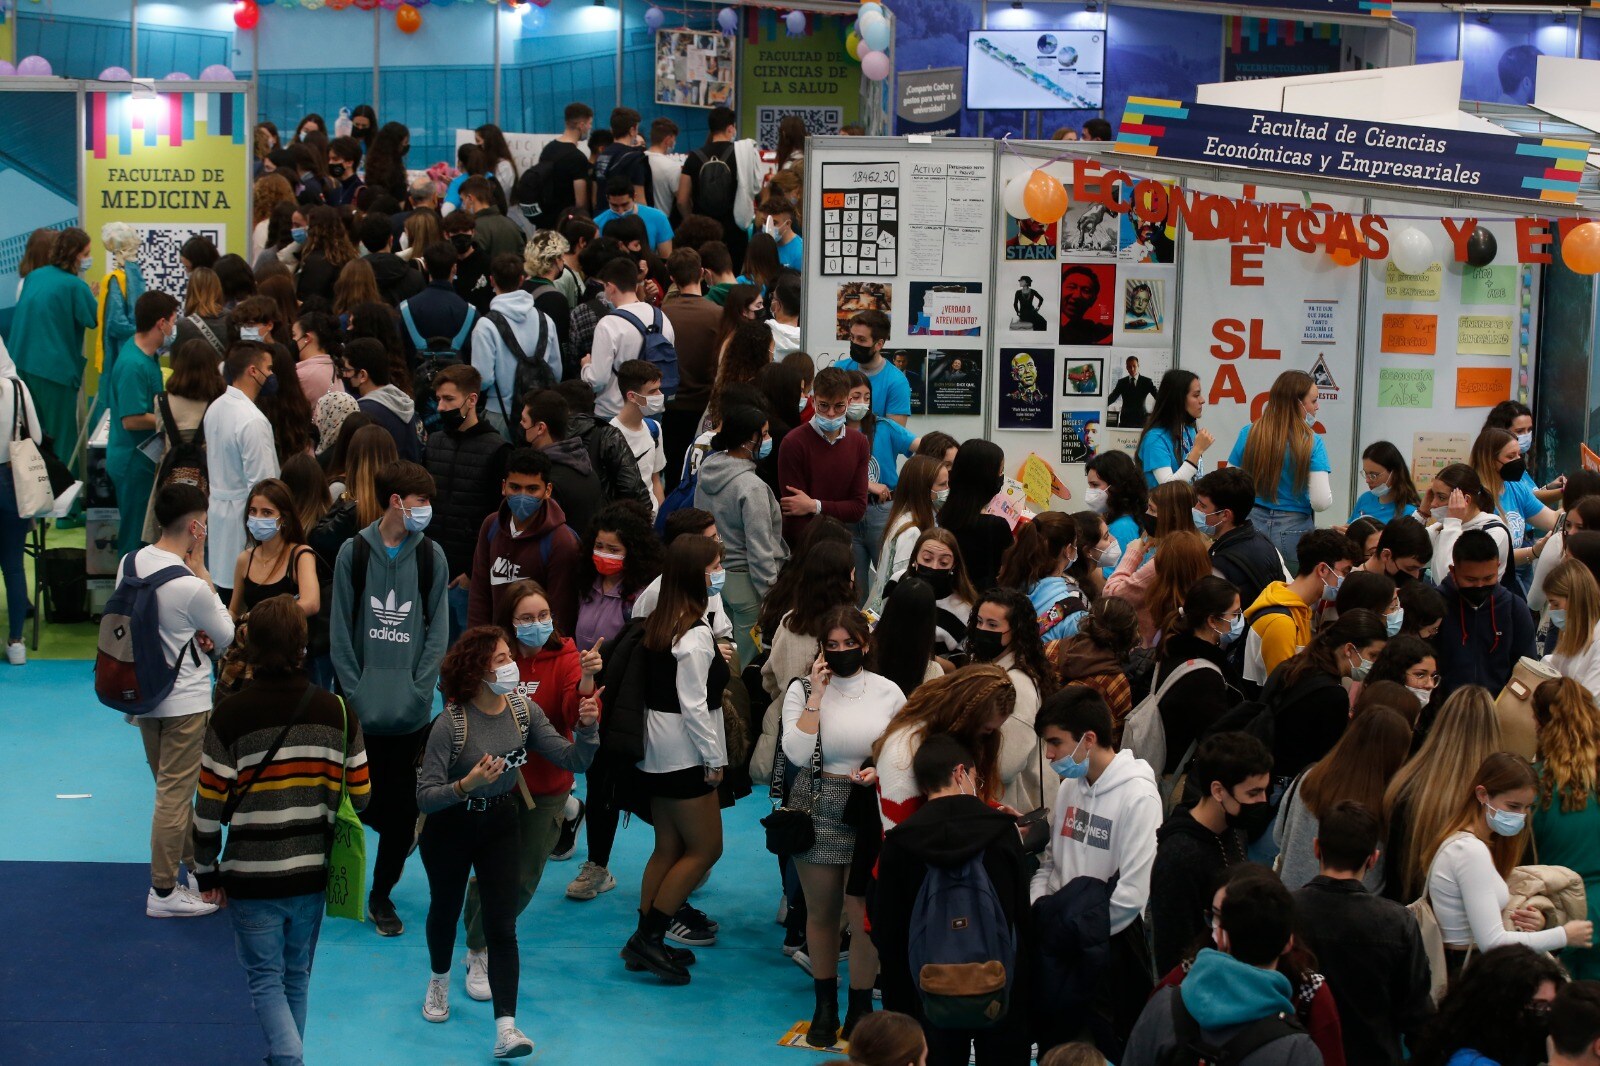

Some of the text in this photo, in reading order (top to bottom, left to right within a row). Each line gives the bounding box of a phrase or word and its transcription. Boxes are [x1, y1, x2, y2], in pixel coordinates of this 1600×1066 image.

[759, 51, 845, 62] FACULTAD DE
[753, 66, 848, 78] CIENCIAS DE
[763, 82, 838, 94] LA SALUD
[933, 83, 949, 91] Coche
[1248, 114, 1447, 154] Facultad de Ciencias
[1203, 136, 1481, 185] Económicas y Empresariales
[108, 168, 224, 182] FACULTAD DE
[912, 164, 942, 174] ACTIVO
[101, 190, 231, 209] MEDICINA
[846, 196, 859, 206] OFF
[828, 212, 834, 221] 7
[847, 212, 853, 222] 8
[866, 212, 873, 222] 9
[828, 226, 874, 238] 4 5 6
[1440, 217, 1478, 262] Y
[830, 242, 871, 256] 1 2 3
[1006, 245, 1056, 260] STARK
[830, 259, 837, 272] 0
[1487, 288, 1507, 299] ADE
[941, 305, 972, 315] ¿VERDAD O
[935, 316, 978, 325] ATREVIMIENTO?
[1459, 317, 1504, 328] FINANZAS
[1390, 393, 1420, 406] ADE
[369, 626, 411, 643] adidas
